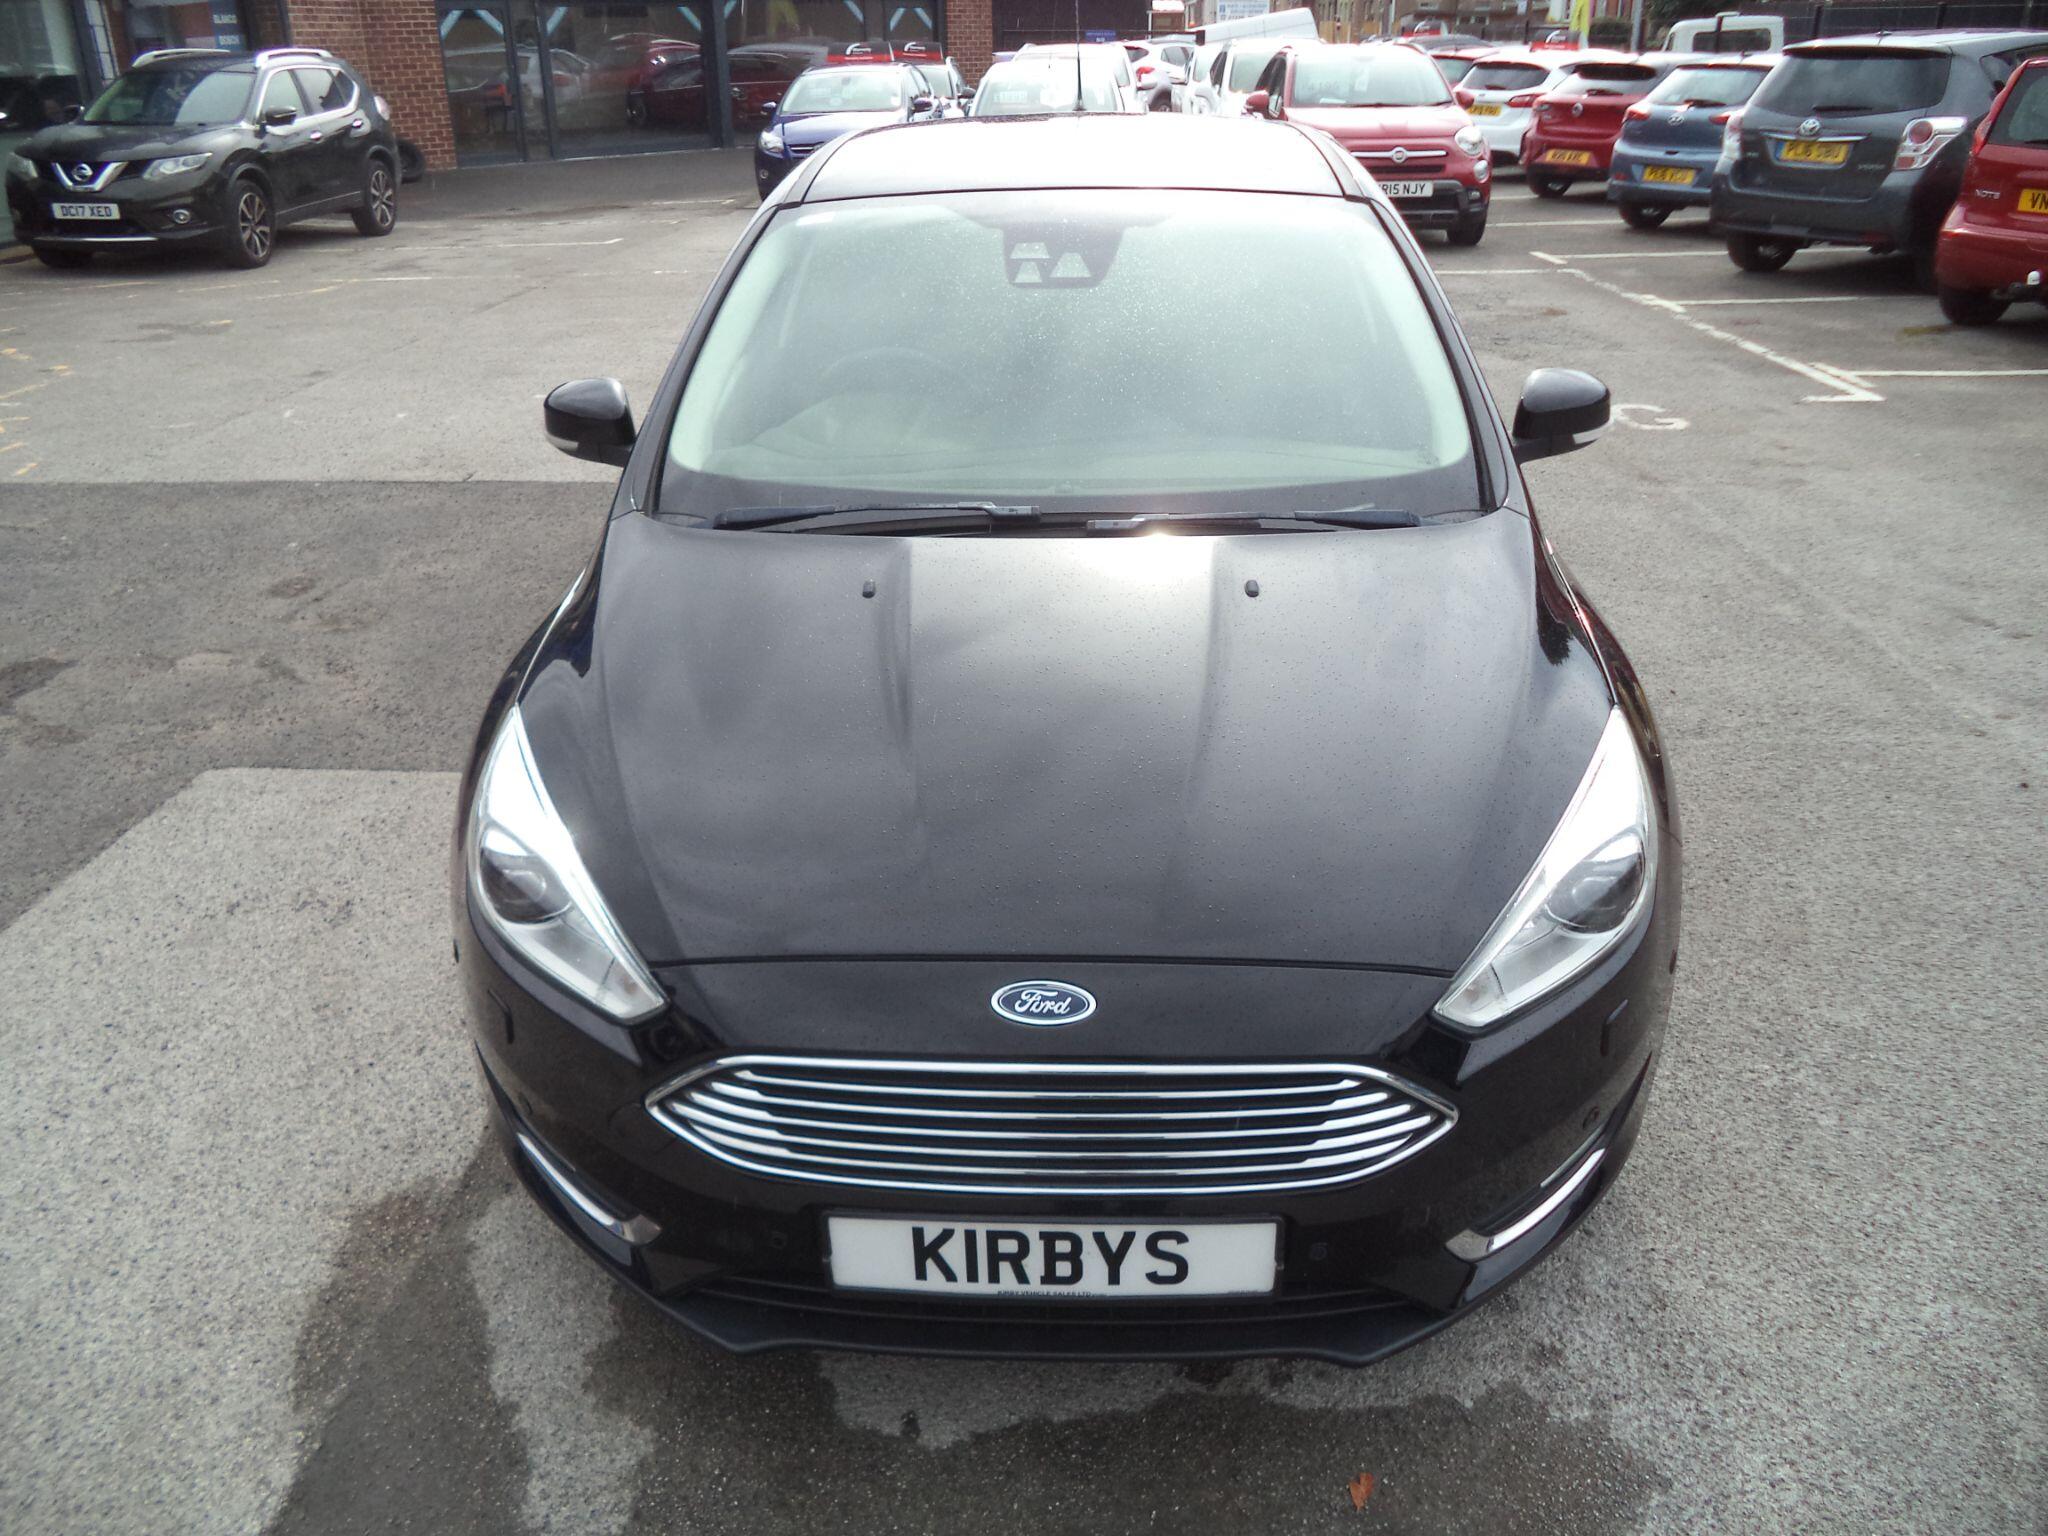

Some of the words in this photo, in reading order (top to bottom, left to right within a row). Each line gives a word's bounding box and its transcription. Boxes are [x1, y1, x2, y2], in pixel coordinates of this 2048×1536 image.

[1379, 183, 1400, 195] R15
[1402, 183, 1426, 195] NJY
[1014, 989, 1072, 1014] Ford
[911, 1226, 1190, 1287] KIRBYS
